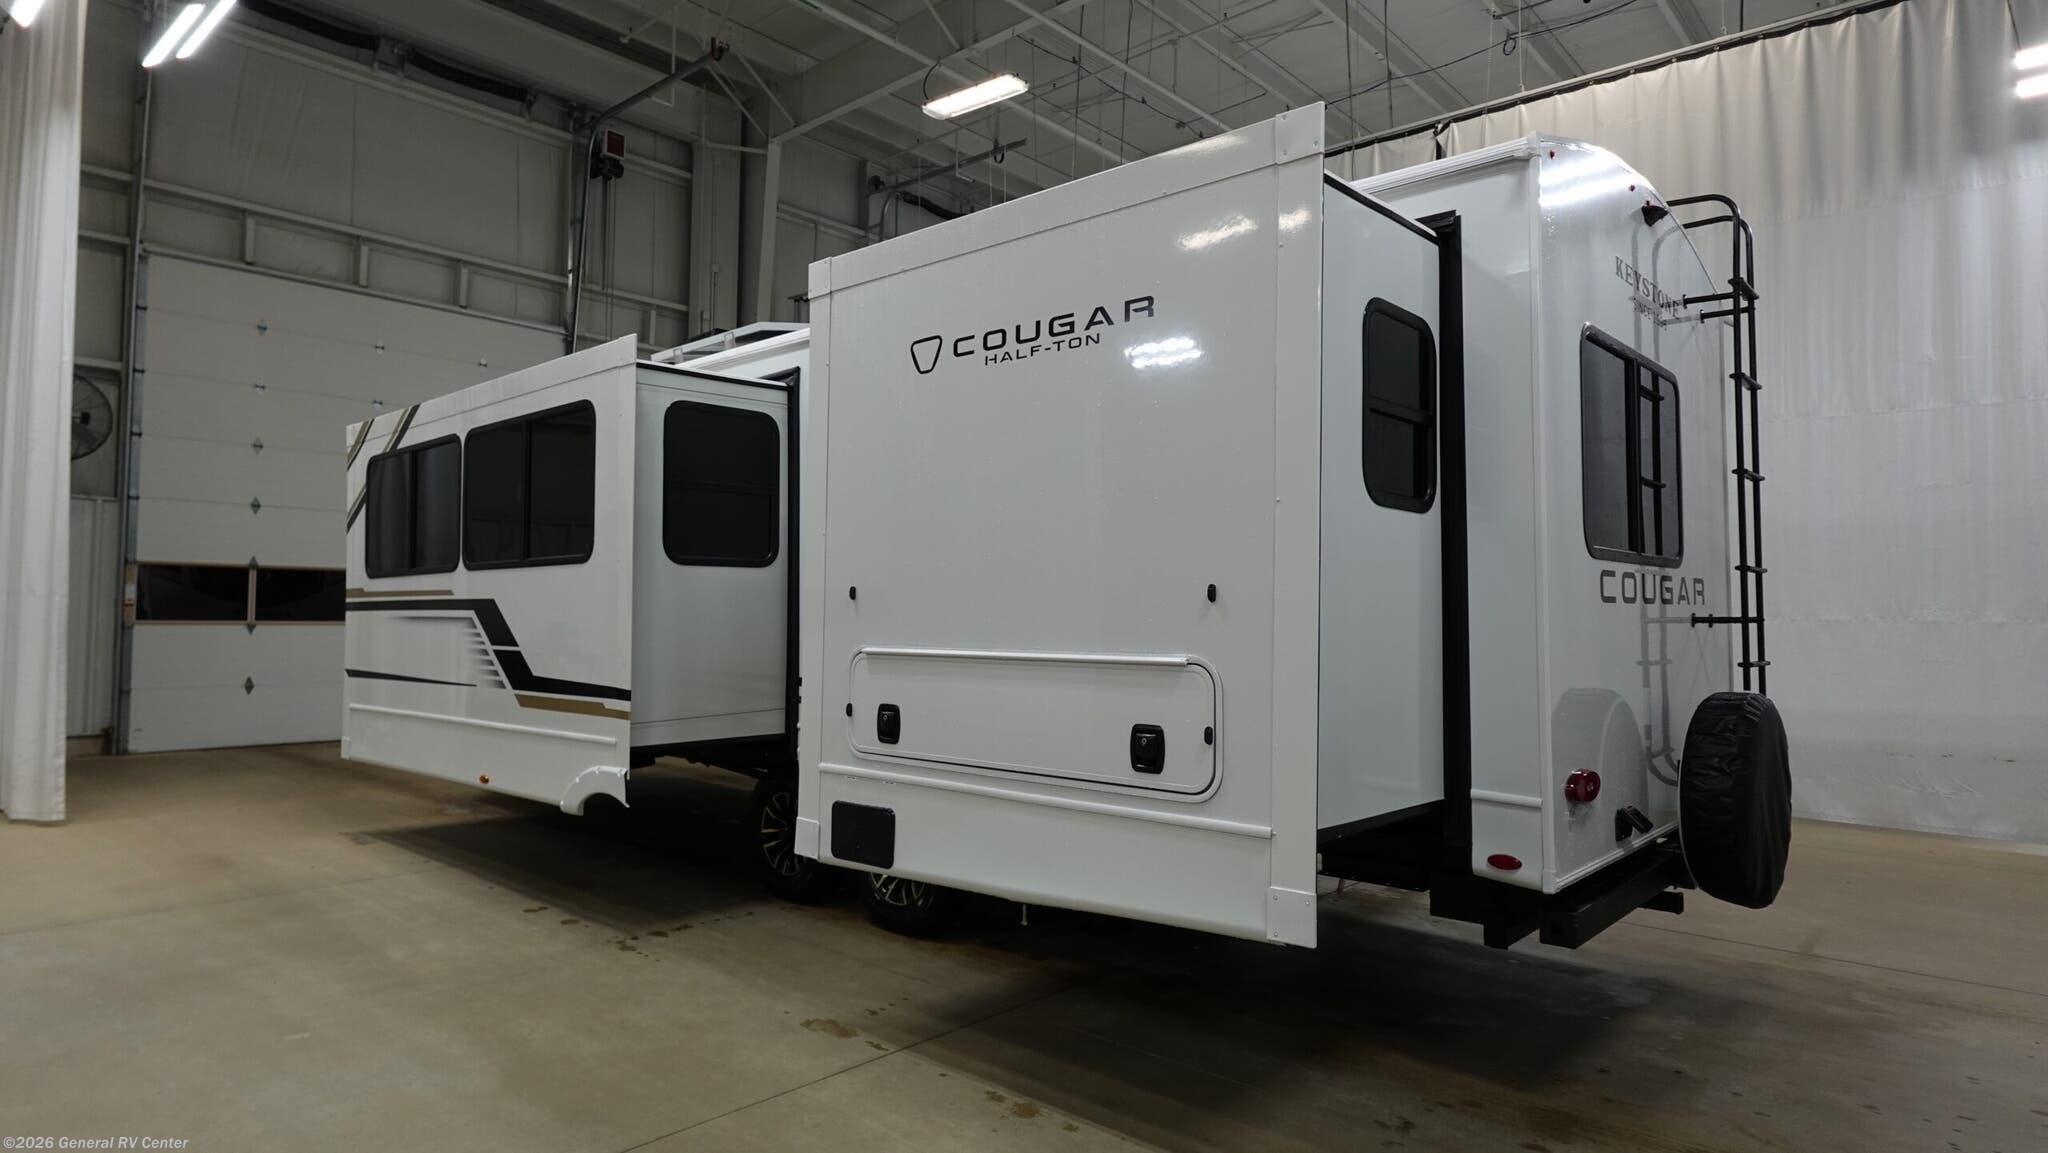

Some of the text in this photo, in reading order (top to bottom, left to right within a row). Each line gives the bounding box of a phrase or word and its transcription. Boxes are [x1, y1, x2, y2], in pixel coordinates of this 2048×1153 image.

[1615, 255, 1680, 320] KEYSTONE
[953, 295, 1155, 358] COUGAR
[984, 332, 1101, 367] HALF-TON
[1599, 569, 1705, 606] COUGAR
